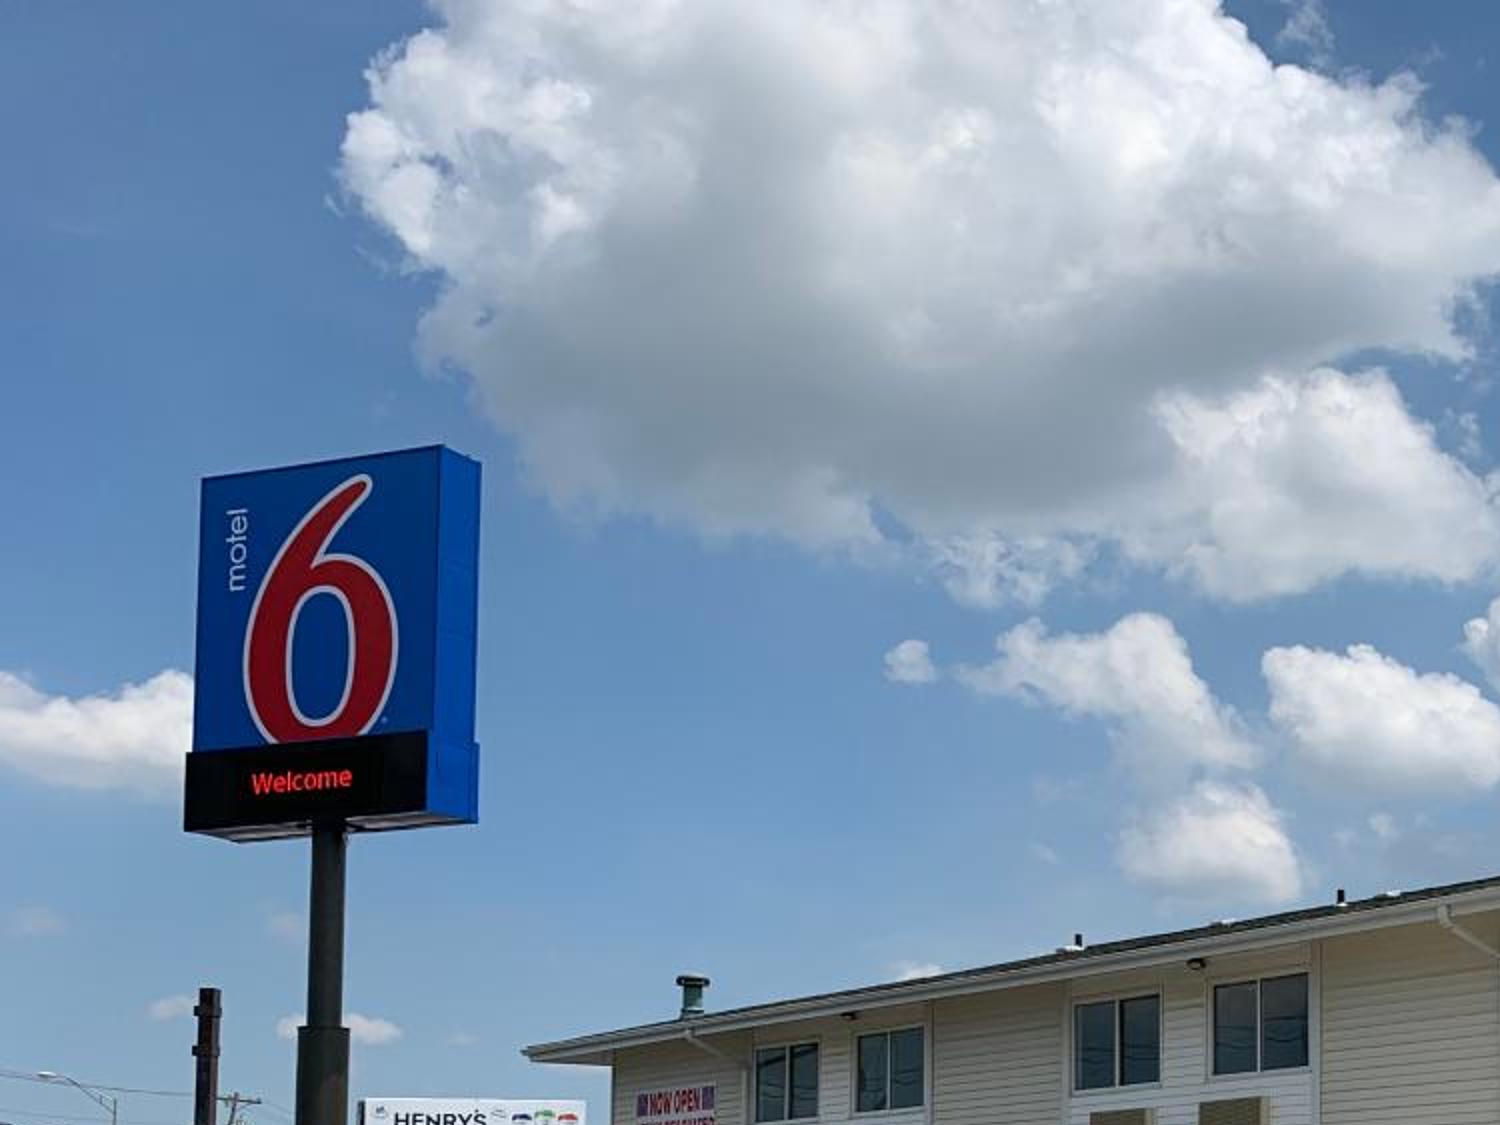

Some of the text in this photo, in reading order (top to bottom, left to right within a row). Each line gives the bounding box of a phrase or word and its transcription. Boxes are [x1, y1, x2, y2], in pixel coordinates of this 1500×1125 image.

[225, 508, 249, 592] motel
[242, 473, 399, 745] 6
[251, 769, 353, 795] Welcome
[649, 1087, 700, 1116] NOW OPEN
